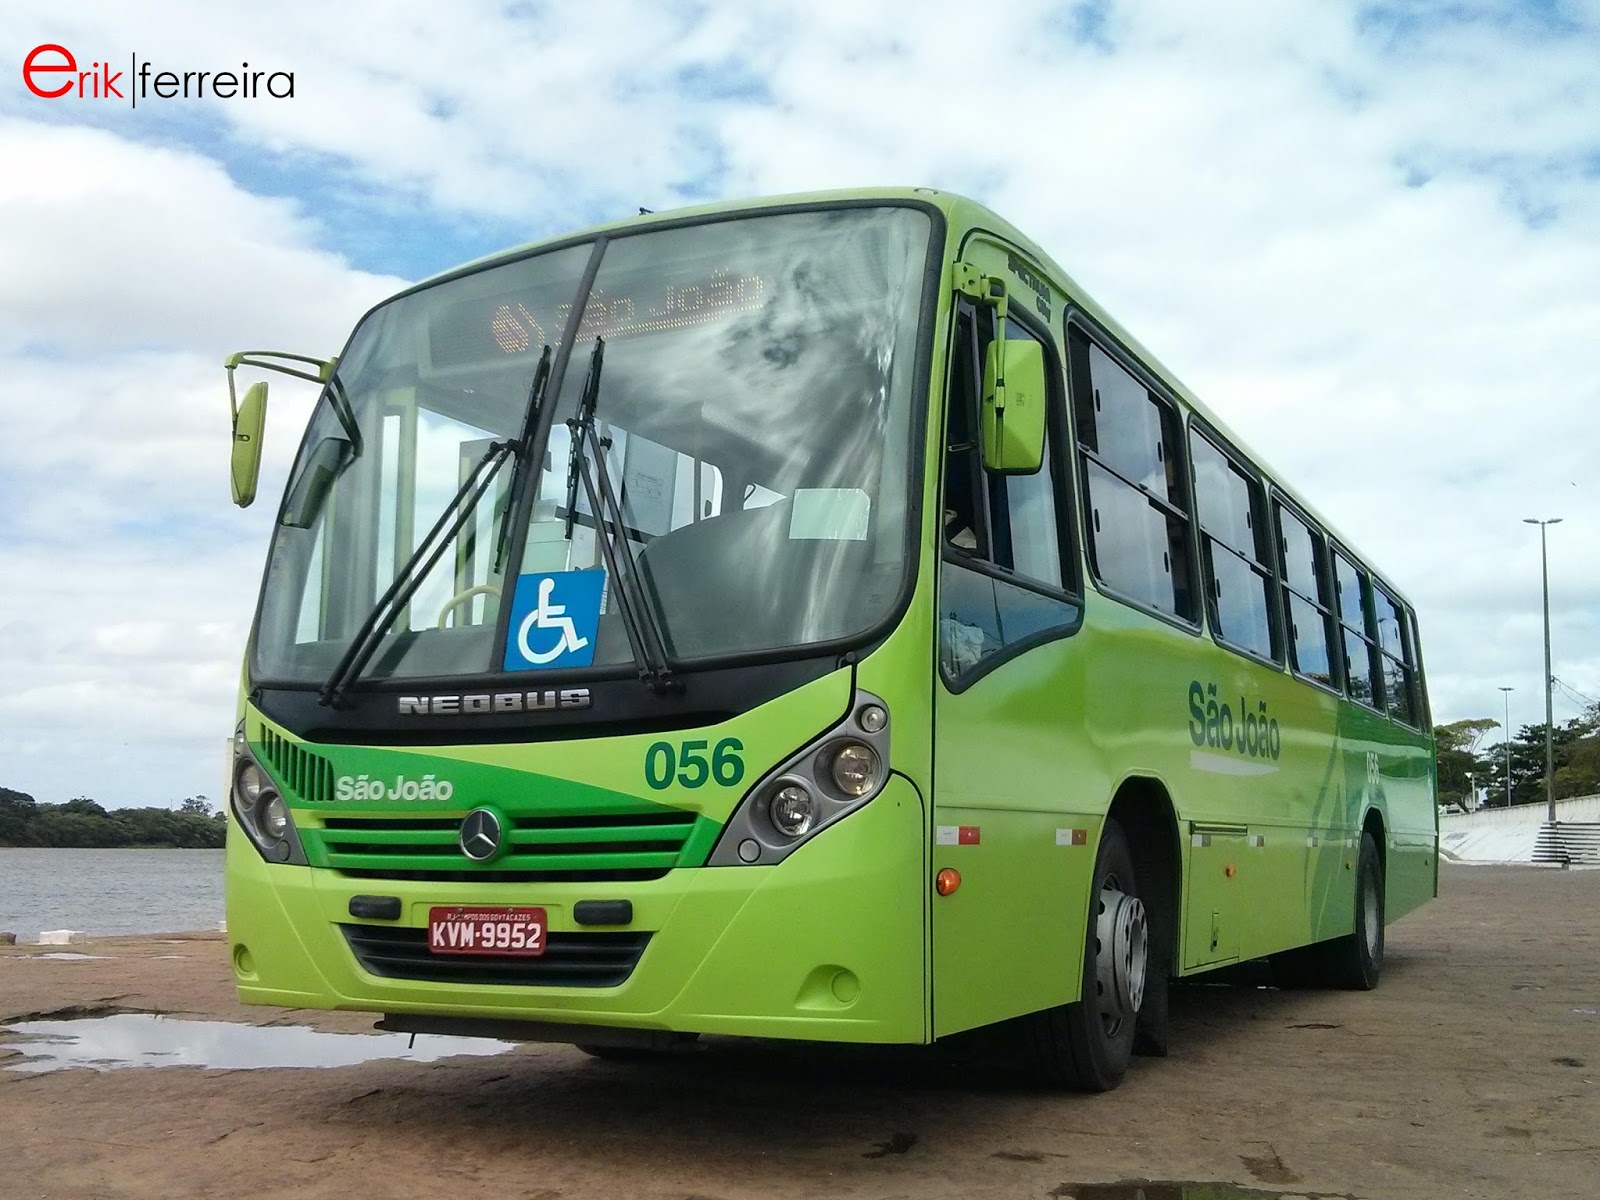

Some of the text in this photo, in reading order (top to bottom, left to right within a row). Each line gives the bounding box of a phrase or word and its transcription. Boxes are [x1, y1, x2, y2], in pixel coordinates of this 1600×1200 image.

[398, 688, 592, 716] NEOBUS
[1187, 680, 1281, 762] São João
[644, 737, 745, 791] 056
[1366, 751, 1380, 785] 056
[335, 774, 453, 801] São João
[432, 922, 541, 948] KVM-9952
